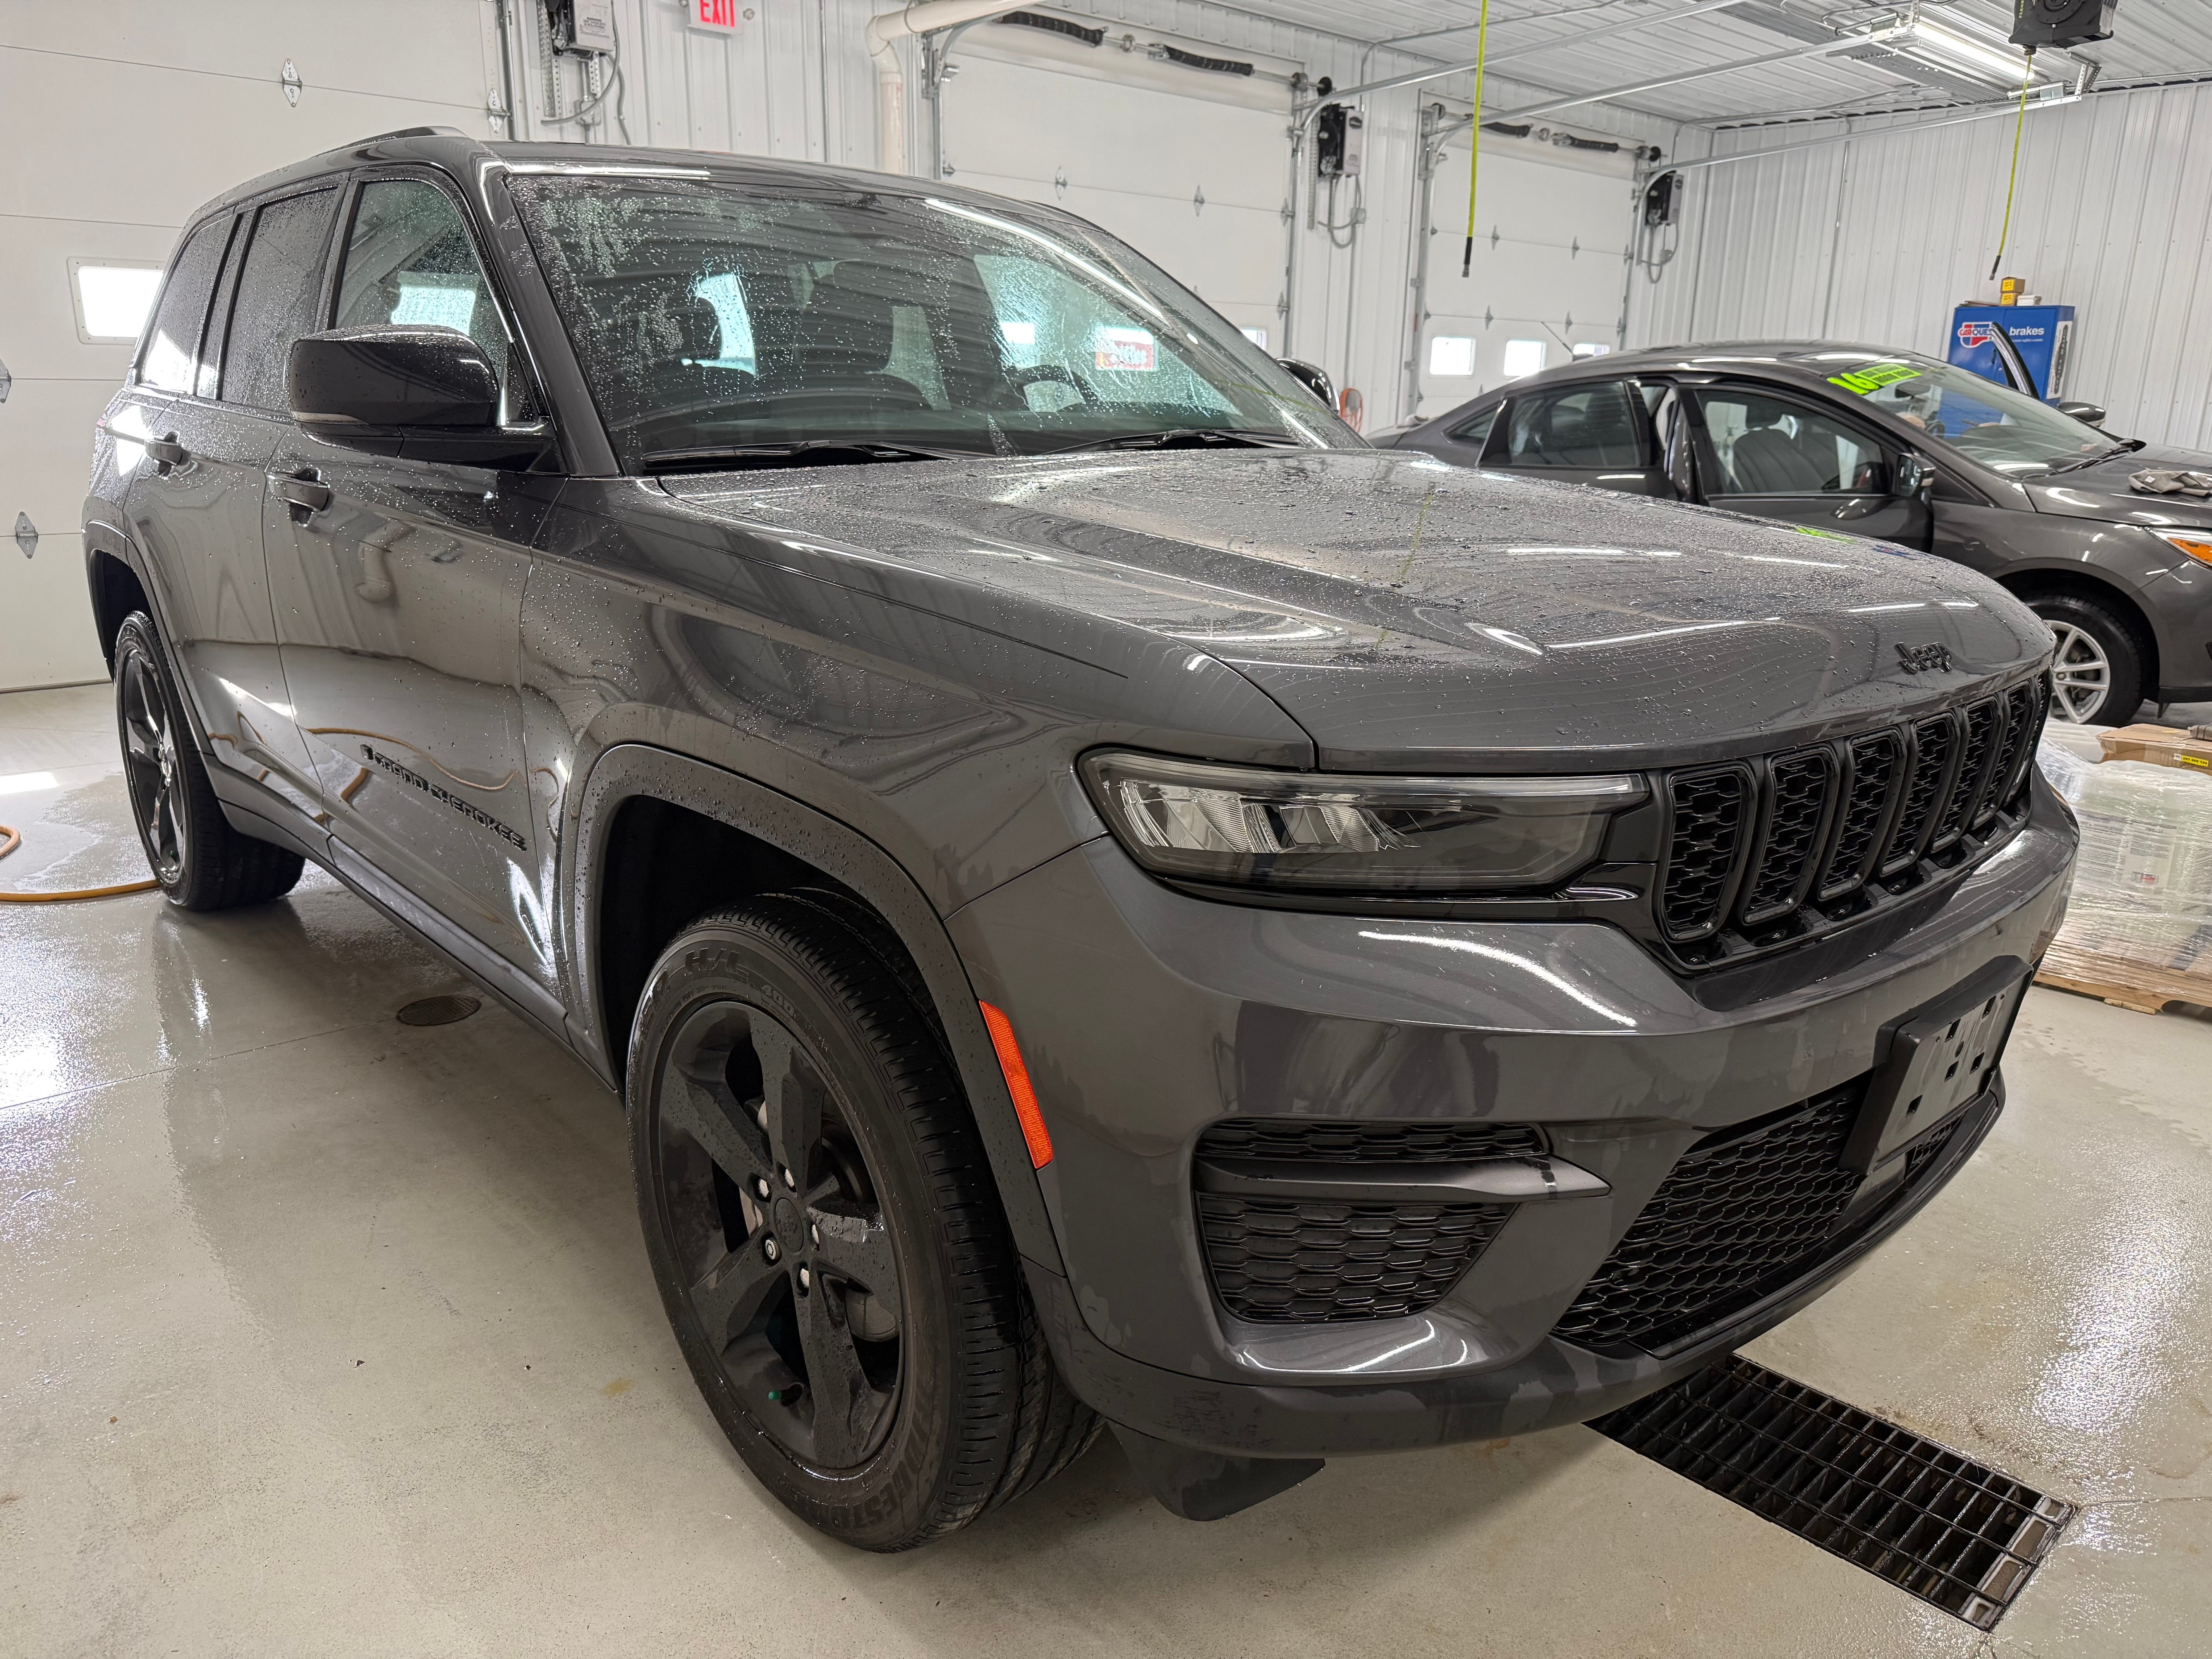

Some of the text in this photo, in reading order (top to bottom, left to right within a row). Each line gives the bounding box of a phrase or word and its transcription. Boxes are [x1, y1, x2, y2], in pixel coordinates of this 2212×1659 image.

[2009, 326, 2044, 336] brakes
[1826, 373, 1879, 395] 16
[1894, 642, 1952, 675] Jeep
[429, 784, 527, 852] CHEROKEE
[761, 984, 795, 1017] 400
